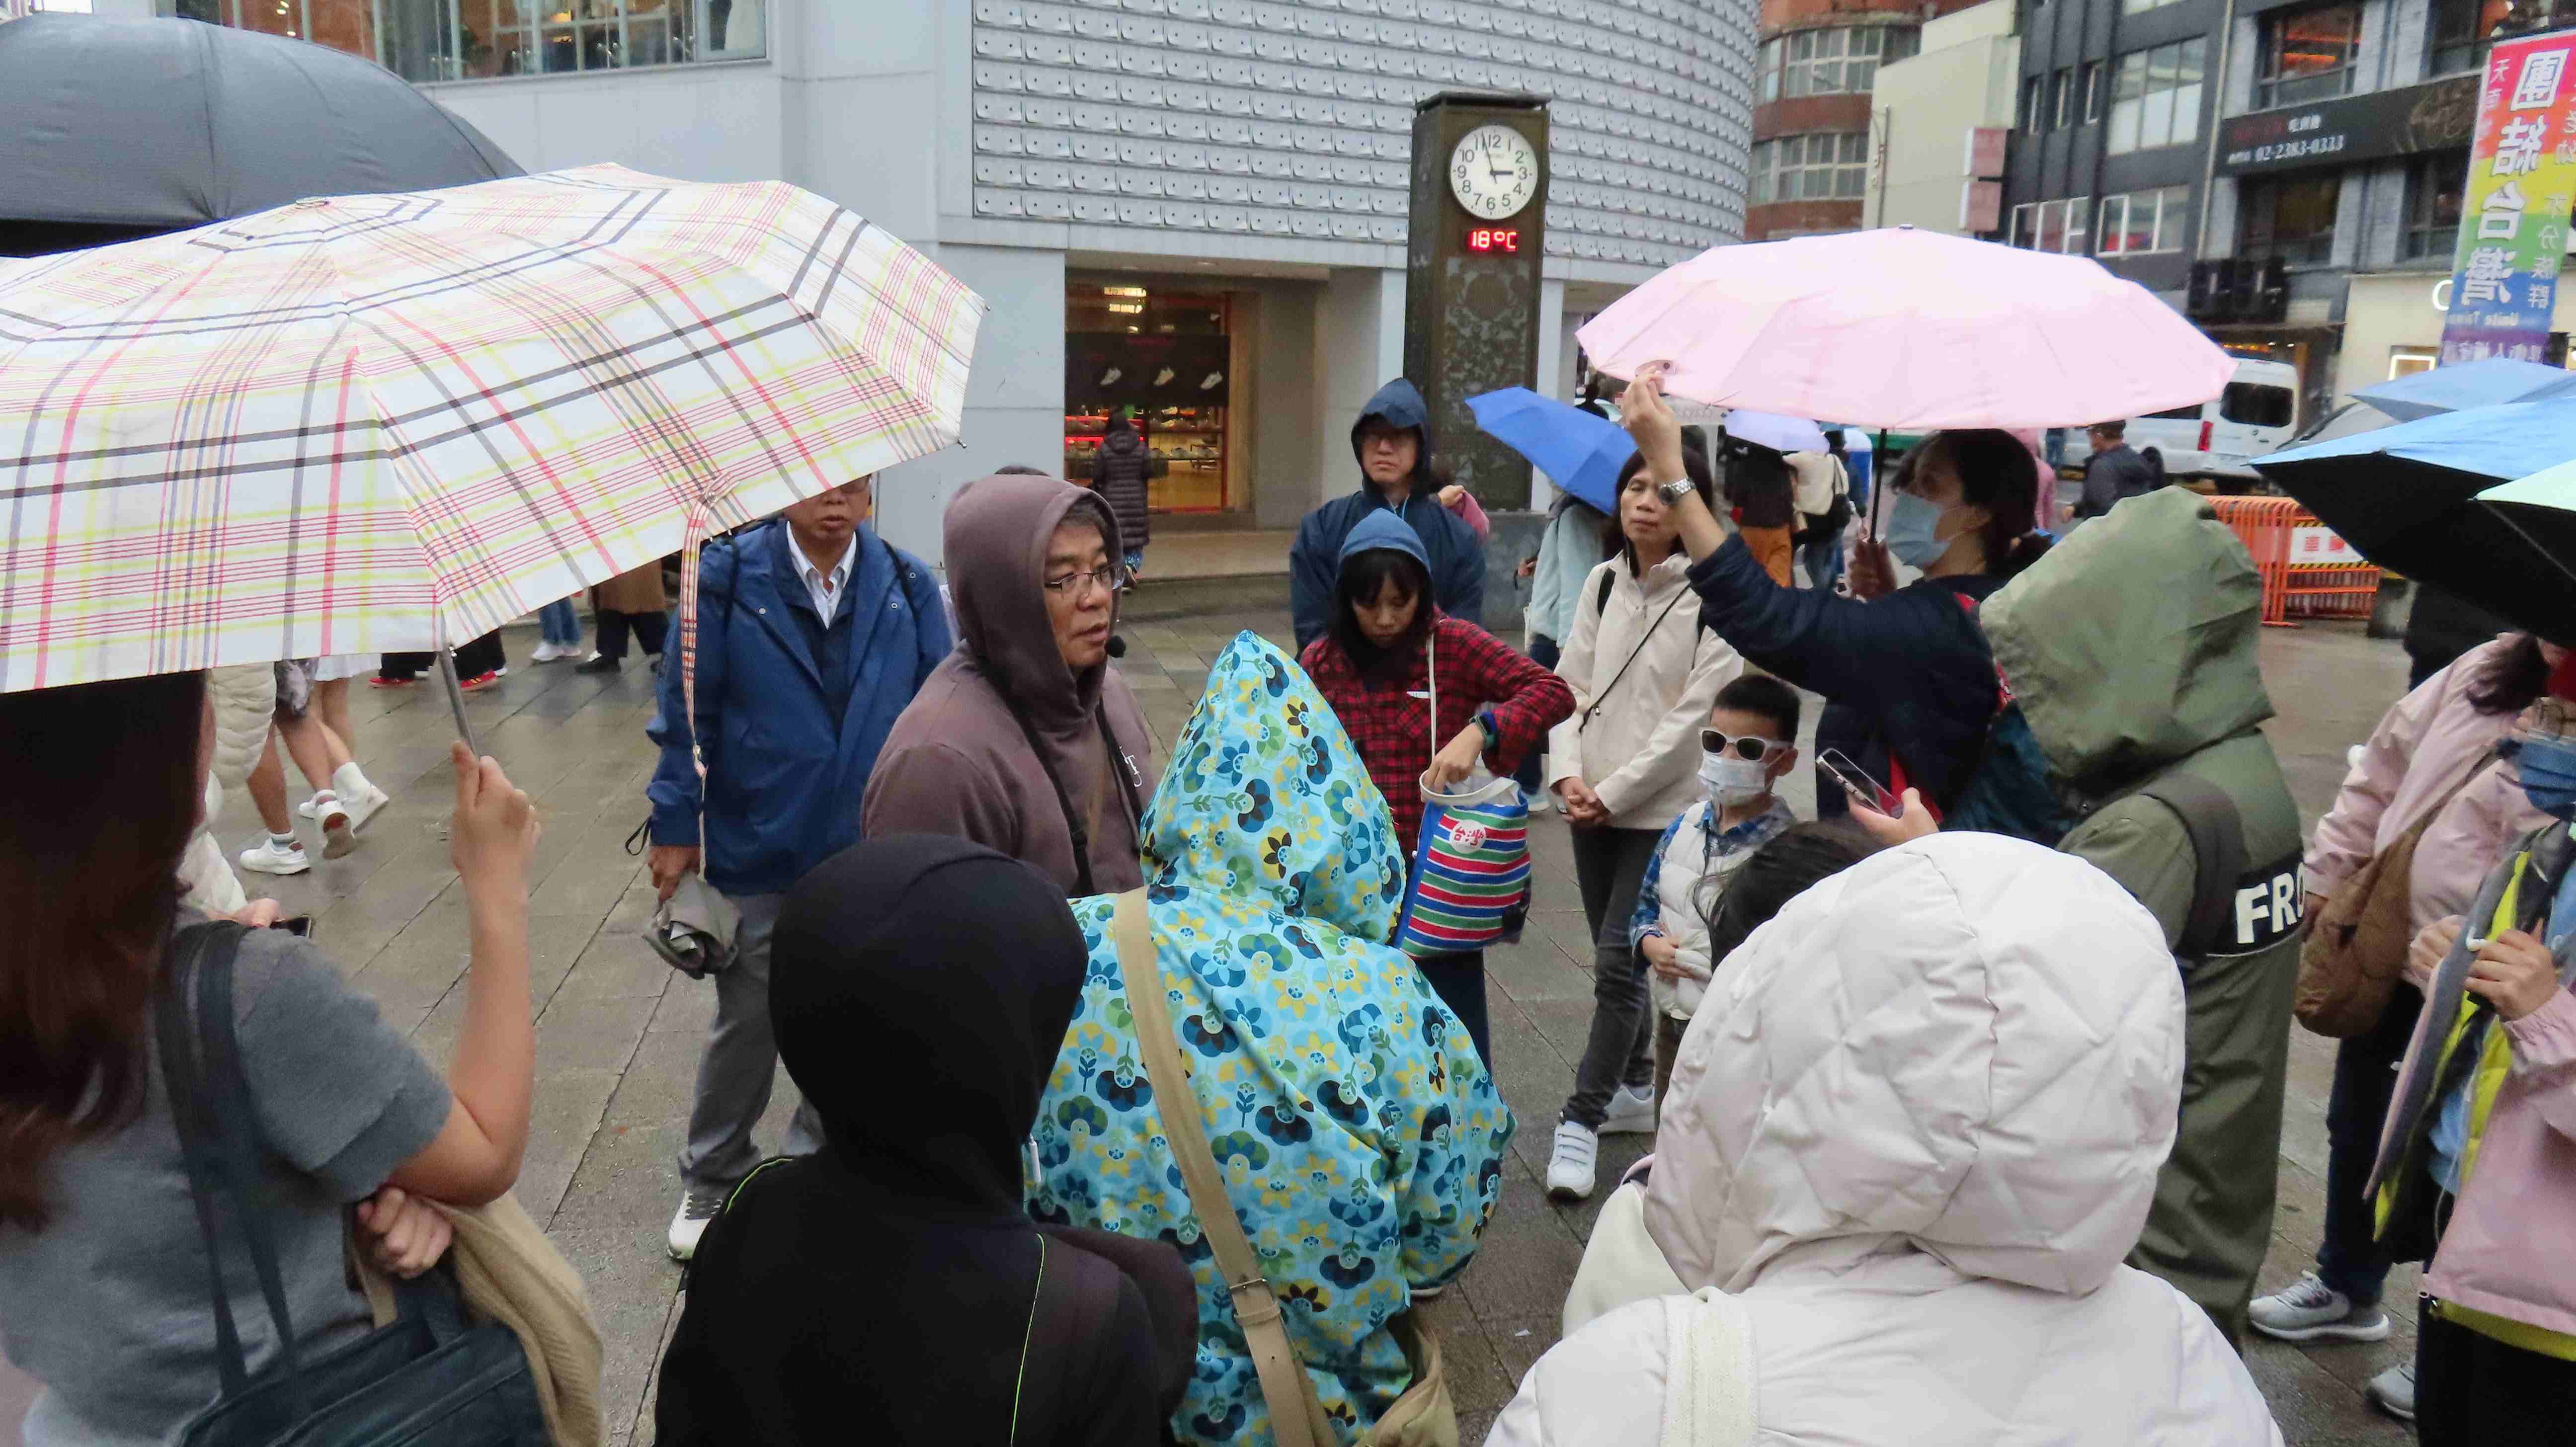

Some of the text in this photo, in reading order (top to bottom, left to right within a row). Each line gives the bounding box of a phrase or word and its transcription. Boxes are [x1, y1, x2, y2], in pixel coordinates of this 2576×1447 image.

[1488, 135, 1501, 148] 12
[1461, 149, 1475, 162] 10
[1515, 150, 1524, 163] 2
[1457, 164, 1467, 178] 9
[1518, 166, 1528, 180] 3
[1462, 179, 1471, 193] 8
[1513, 182, 1522, 194] 4
[1473, 192, 1483, 206] 7
[1486, 197, 1495, 210] 6
[1502, 193, 1511, 207] 5
